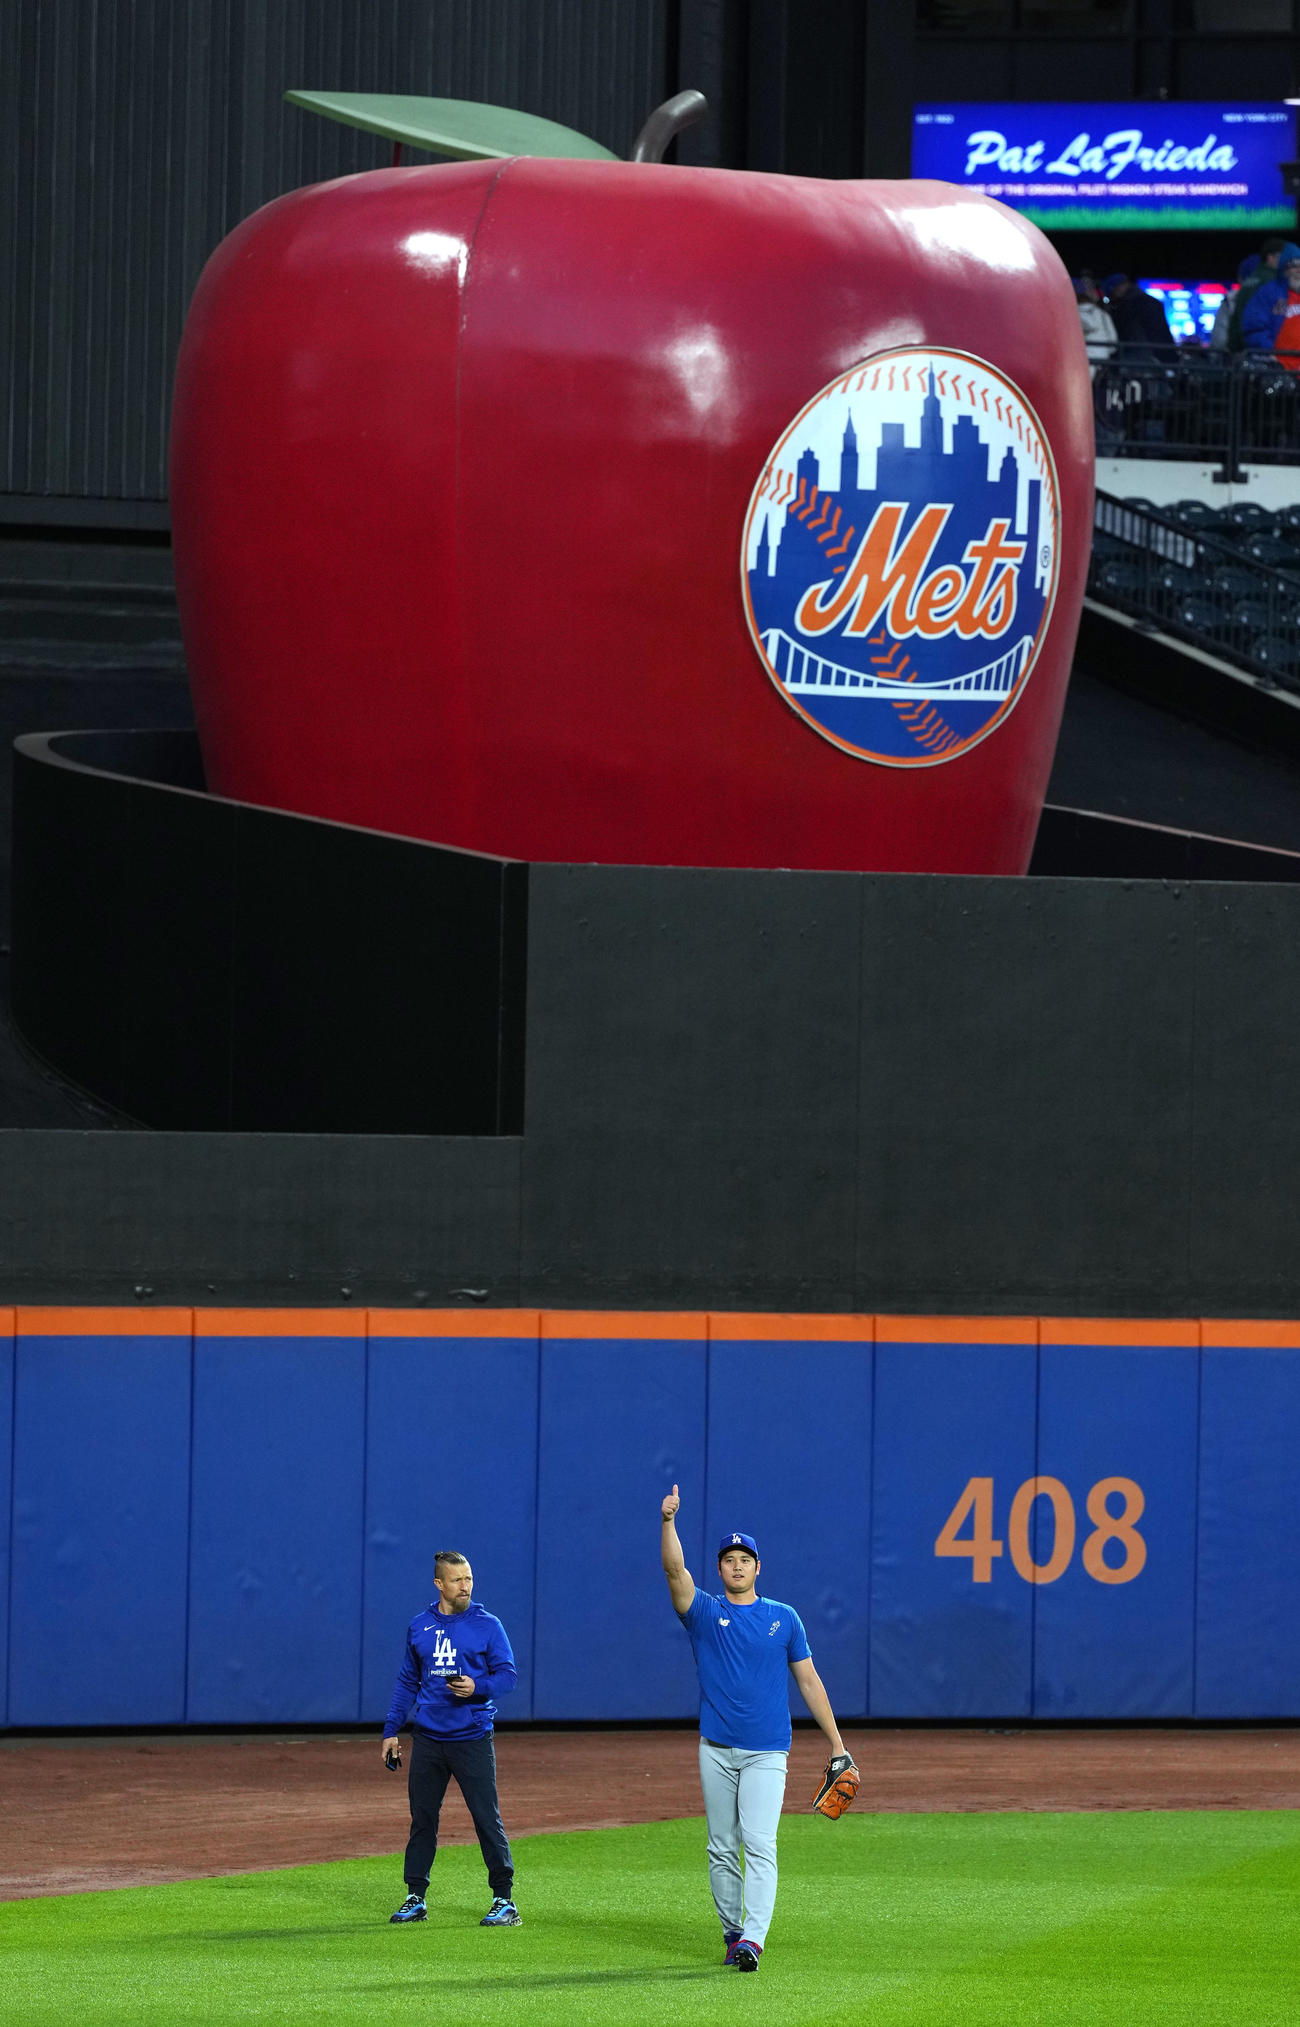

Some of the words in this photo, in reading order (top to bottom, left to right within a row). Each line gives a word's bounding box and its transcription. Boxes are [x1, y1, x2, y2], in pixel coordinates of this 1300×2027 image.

[965, 130, 1045, 175] Pat
[1045, 129, 1238, 180] LaFrieda
[1004, 183, 1025, 196] THE
[1025, 183, 1076, 196] ORIGINAL
[1188, 183, 1248, 196] SANDWICH
[794, 501, 1028, 640] Mets
[934, 1475, 1147, 1585] 408
[432, 1629, 457, 1666] LA
